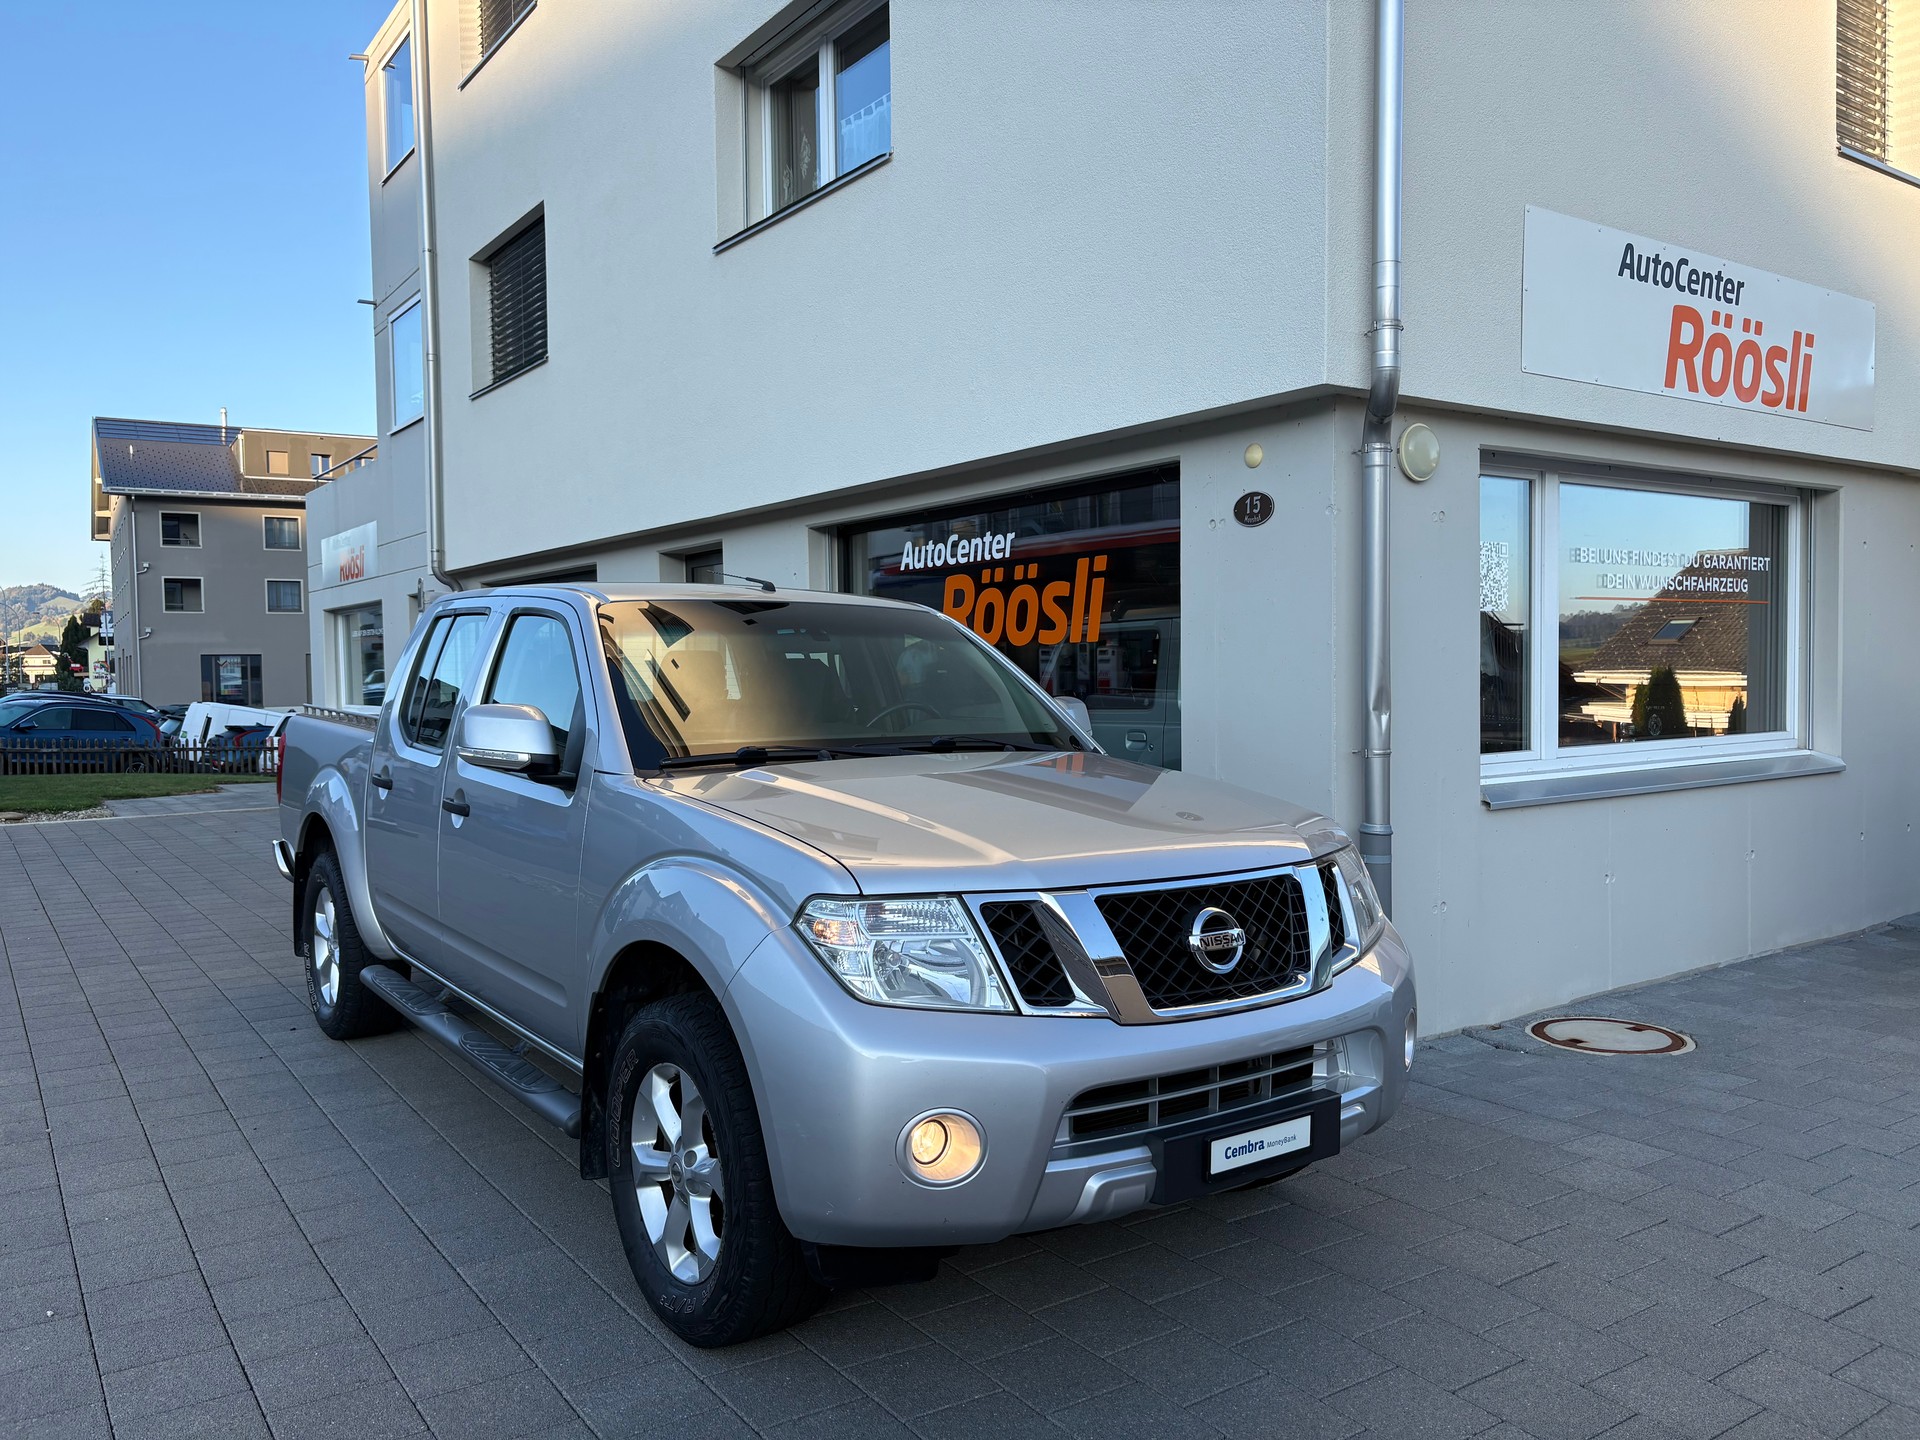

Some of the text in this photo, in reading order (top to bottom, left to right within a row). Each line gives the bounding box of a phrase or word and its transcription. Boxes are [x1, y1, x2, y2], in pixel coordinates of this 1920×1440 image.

[1617, 242, 1745, 306] AutoCenter
[1663, 304, 1815, 413] Röösli
[1245, 495, 1262, 515] 15
[900, 531, 1016, 571] AutoCenter
[1580, 547, 1771, 572] BEI UNS FINDEST DU GARANTIERT
[1606, 573, 1749, 593] DEIN WUNSCHFAHRZEUG
[943, 554, 1108, 647] Röösli
[1200, 931, 1245, 948] NISSAN
[1224, 1134, 1297, 1160] Cembra MoneyBank
